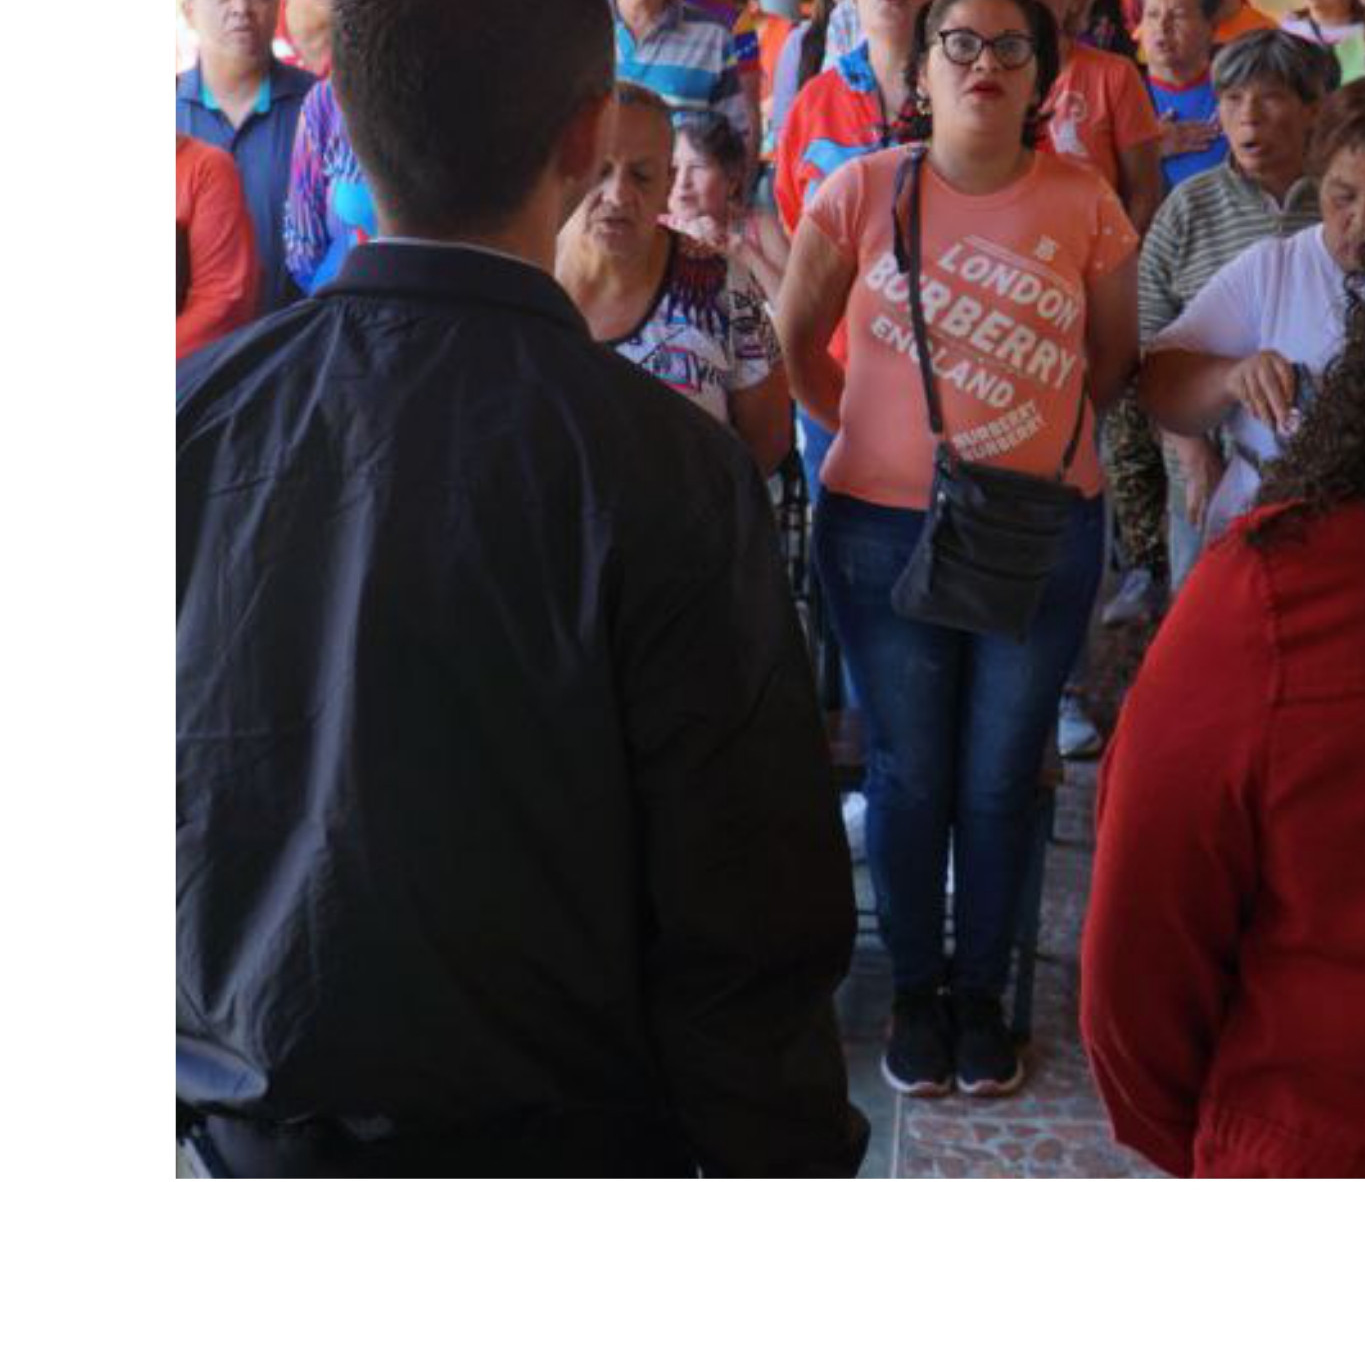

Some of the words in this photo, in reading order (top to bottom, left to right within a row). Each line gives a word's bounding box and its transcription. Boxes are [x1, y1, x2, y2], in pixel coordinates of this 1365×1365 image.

[865, 250, 1077, 390] BURBERRY
[938, 242, 1080, 333] LONDON
[870, 314, 1015, 408] ENLAND
